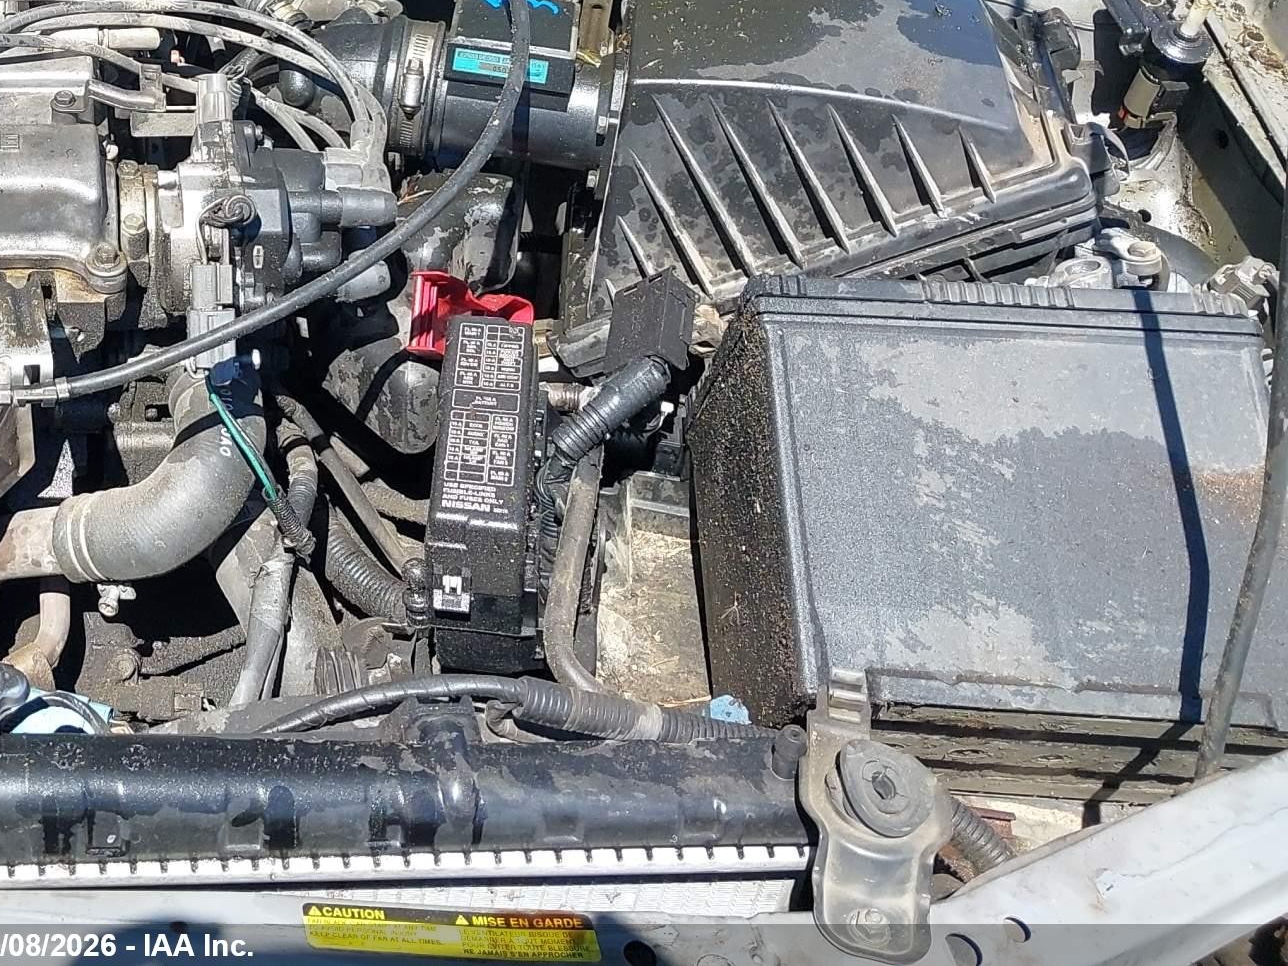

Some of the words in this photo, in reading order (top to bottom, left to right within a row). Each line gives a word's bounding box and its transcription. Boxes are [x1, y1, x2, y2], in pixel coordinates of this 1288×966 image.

[441, 499, 490, 511] NISSAN
[322, 906, 385, 919] CAUTION
[472, 916, 506, 927] MISE
[509, 917, 528, 927] EN
[532, 918, 584, 928] GARDE
[531, 950, 584, 960] APPROCHER
